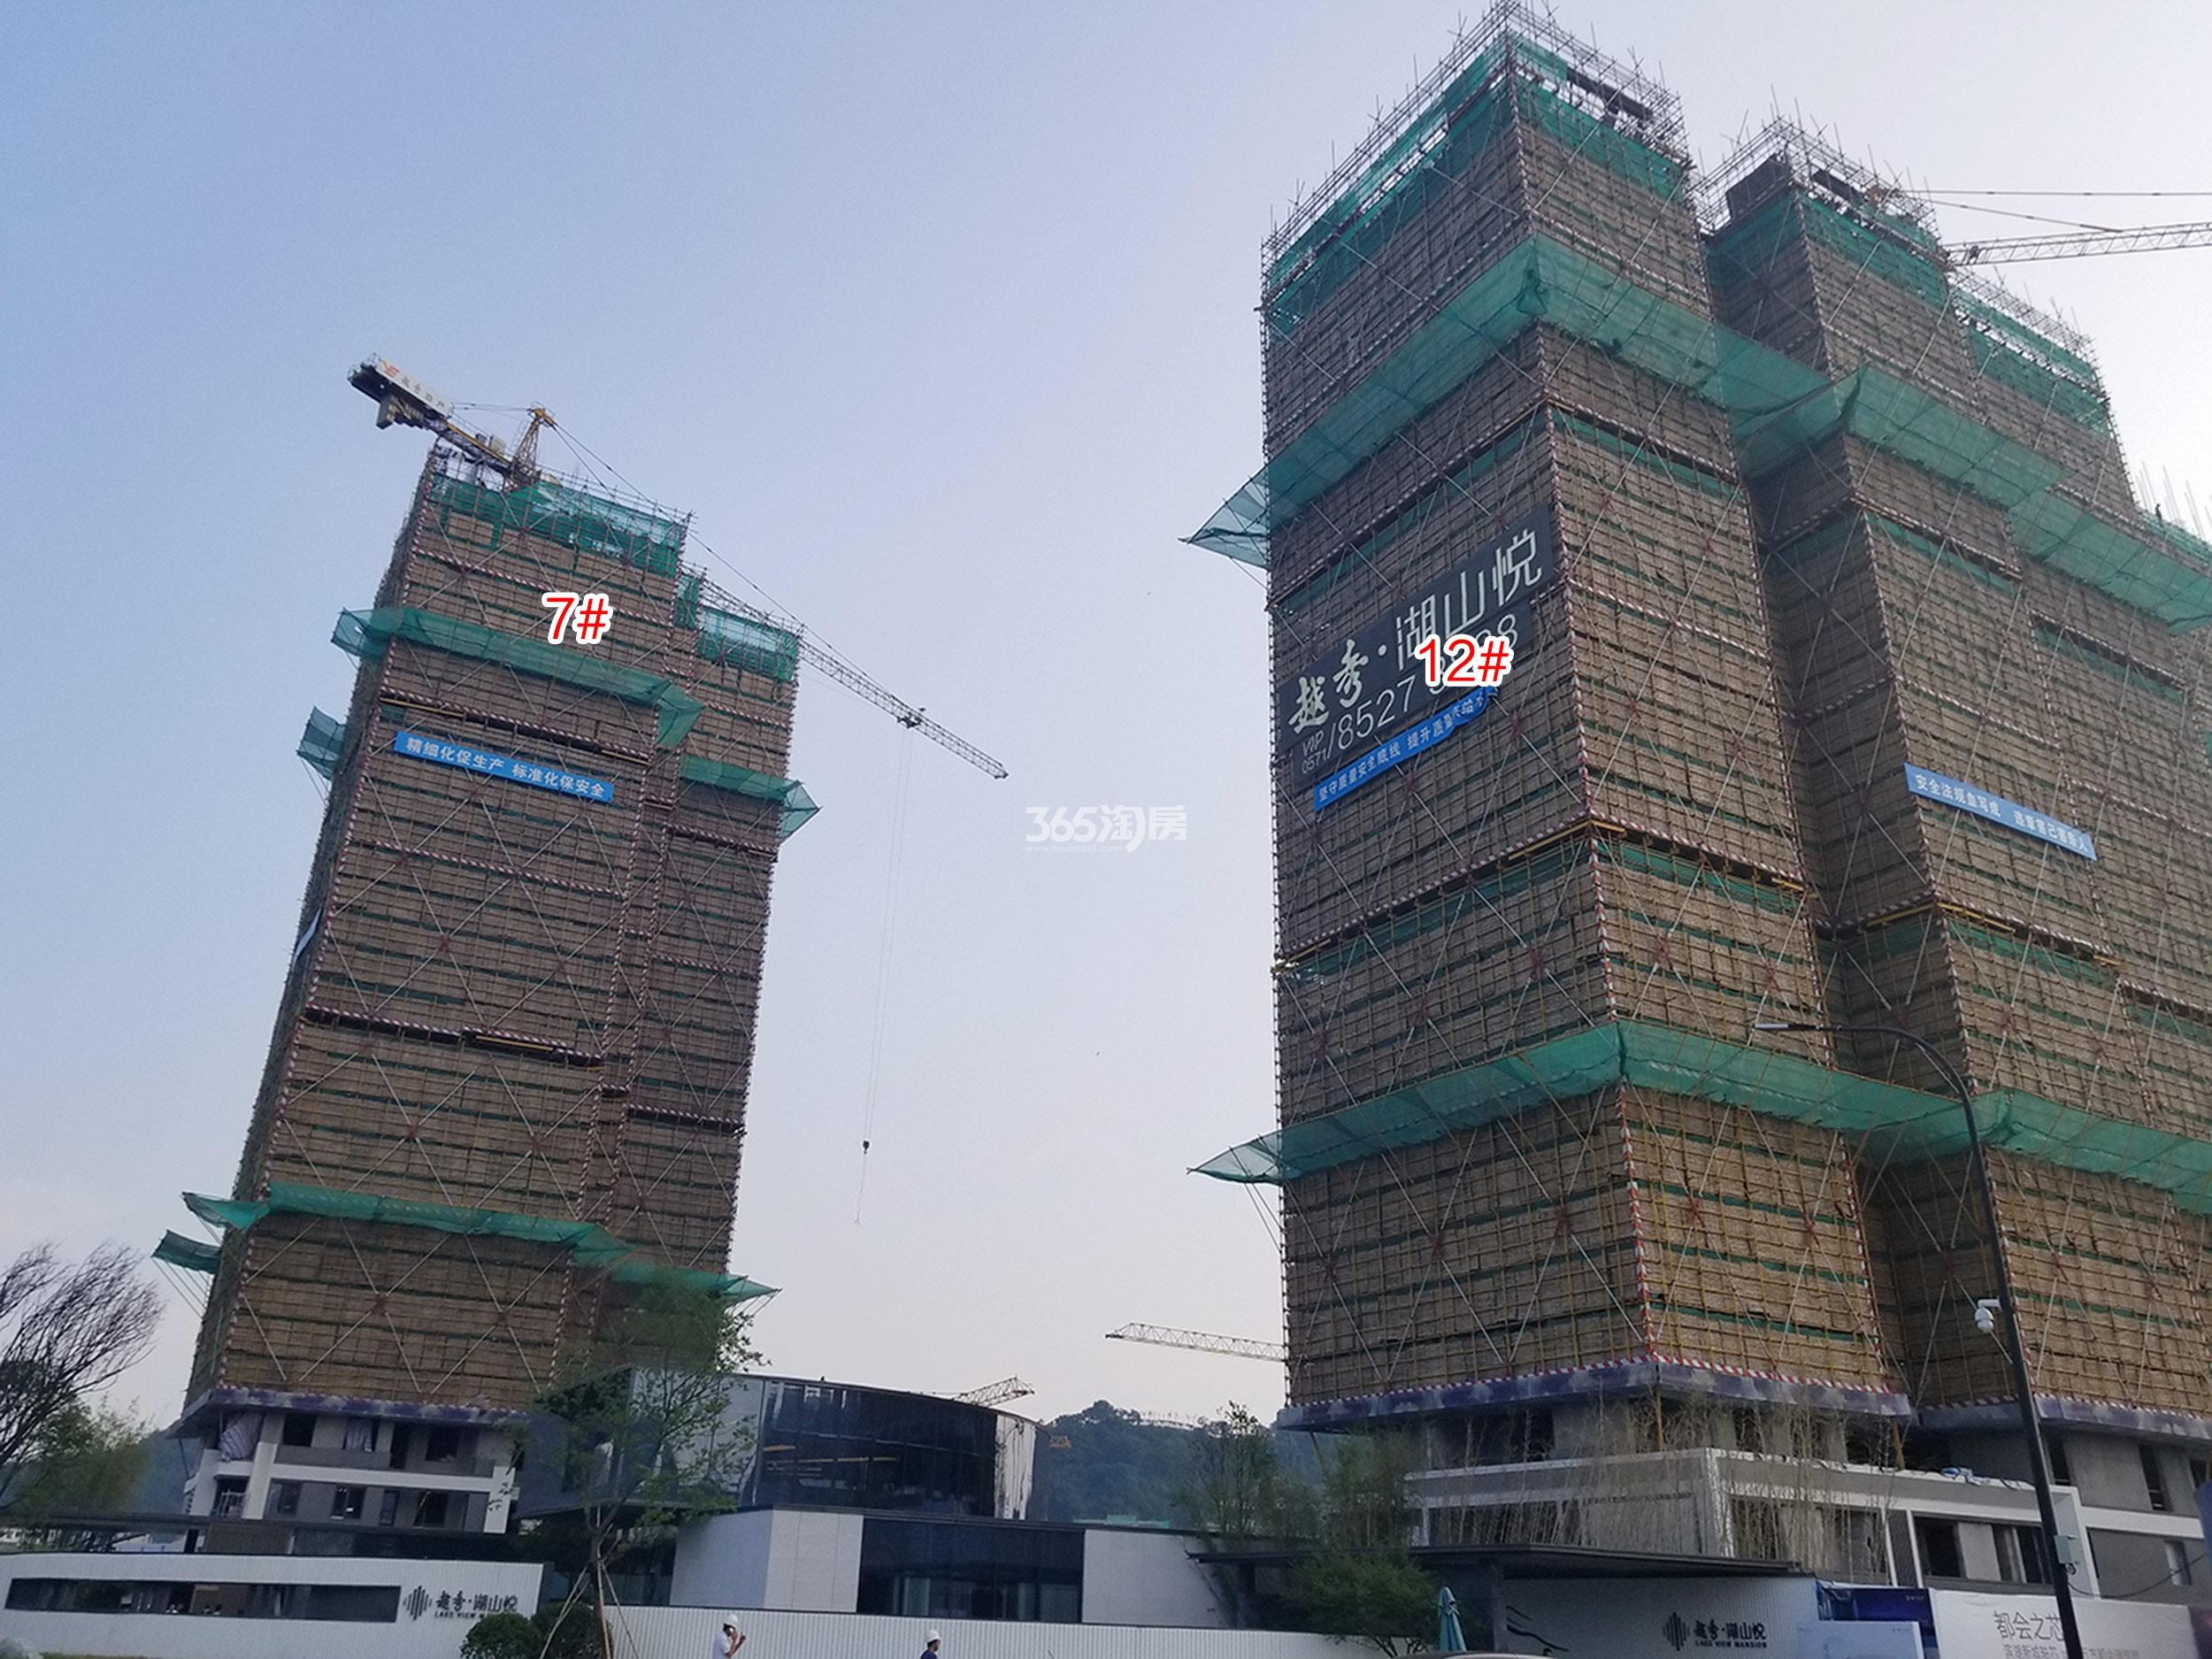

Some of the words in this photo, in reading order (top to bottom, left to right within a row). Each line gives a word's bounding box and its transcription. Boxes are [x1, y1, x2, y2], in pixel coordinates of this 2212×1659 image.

[1302, 730, 1324, 757] VIP
[406, 738, 505, 770] 精细化促生产
[512, 764, 604, 796] 标准化保安全
[1302, 747, 1326, 774] 0571
